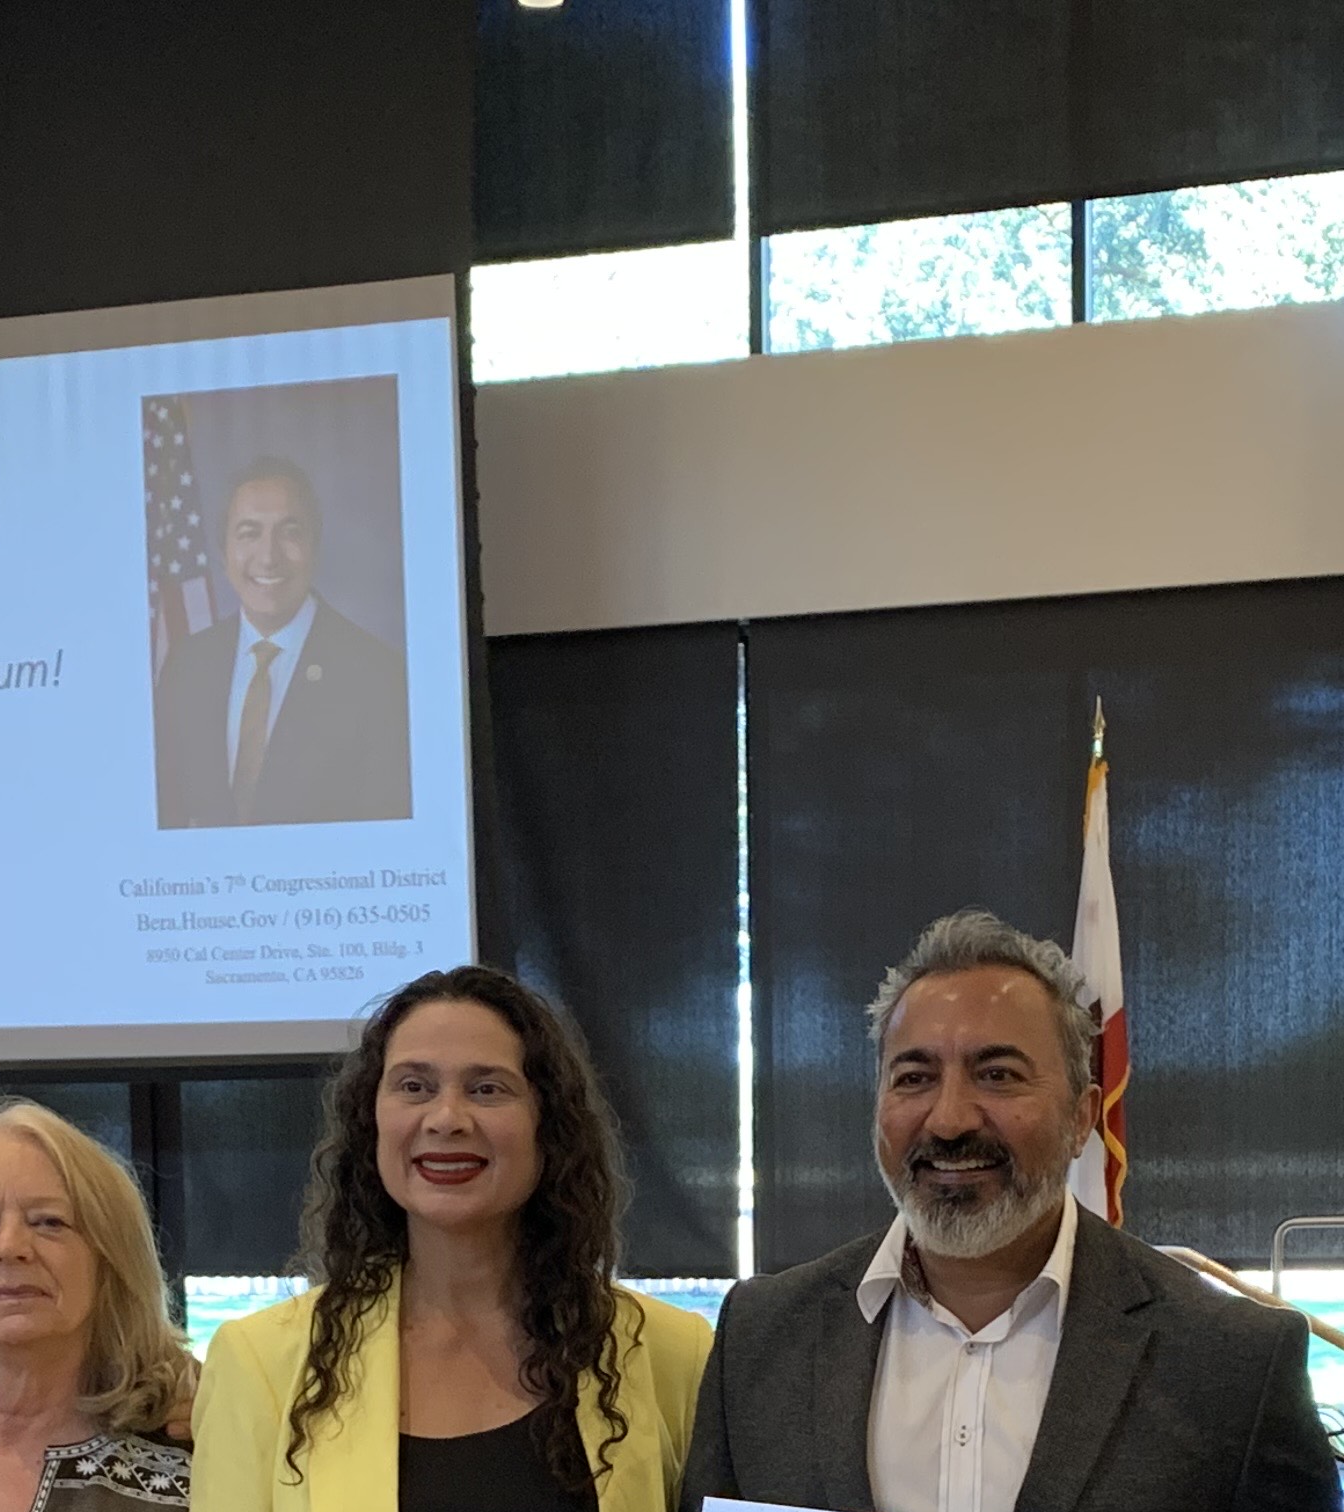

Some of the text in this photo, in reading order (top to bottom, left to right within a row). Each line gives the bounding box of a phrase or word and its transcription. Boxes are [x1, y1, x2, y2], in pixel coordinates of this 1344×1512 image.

[119, 868, 447, 897] California's 7th Congressional District
[137, 903, 431, 931] Bera.House.Gov / (916) 635-0505
[293, 967, 317, 982] CA
